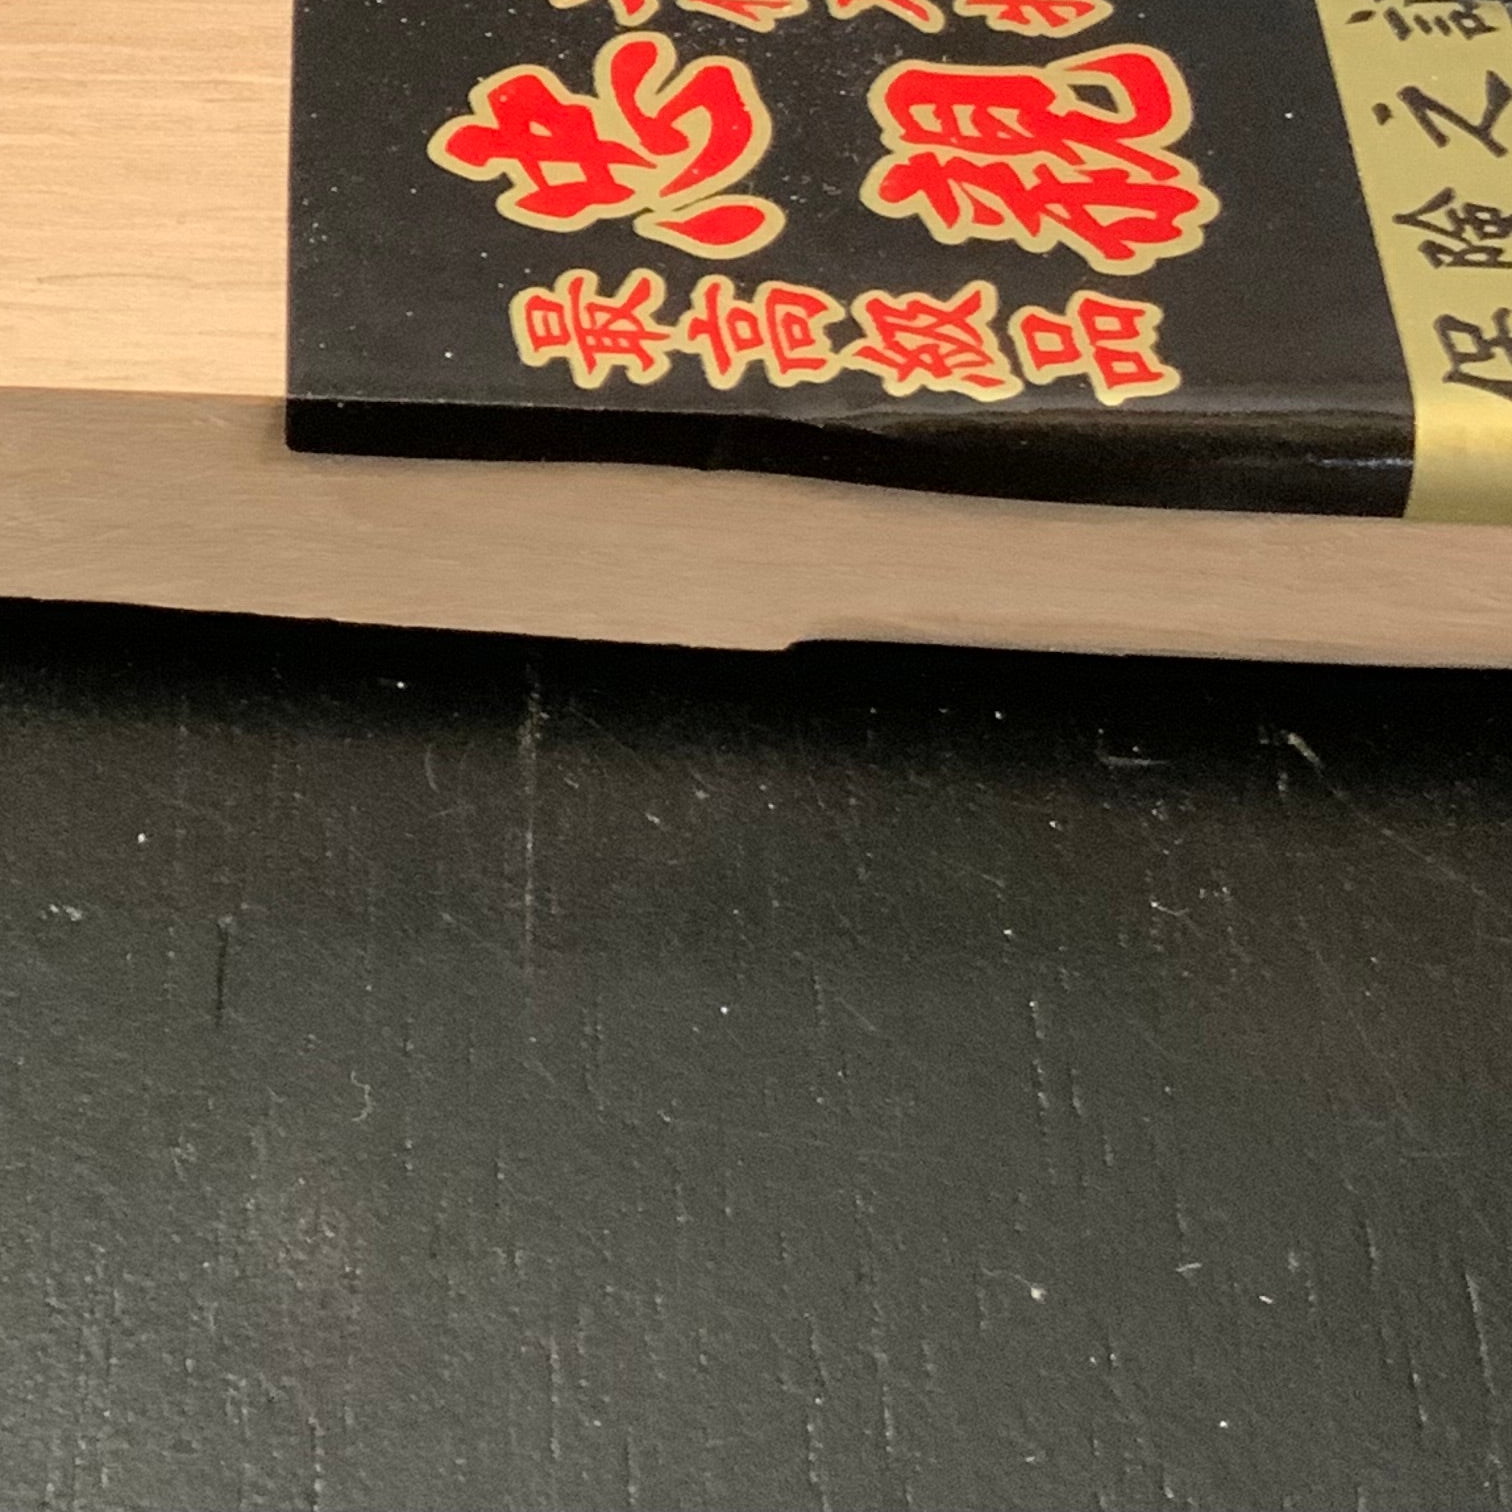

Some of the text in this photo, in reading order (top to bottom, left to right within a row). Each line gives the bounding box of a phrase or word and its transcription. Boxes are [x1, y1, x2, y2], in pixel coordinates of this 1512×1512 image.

[427, 31, 1222, 276] 忠親
[509, 267, 1182, 409] 最高級品
